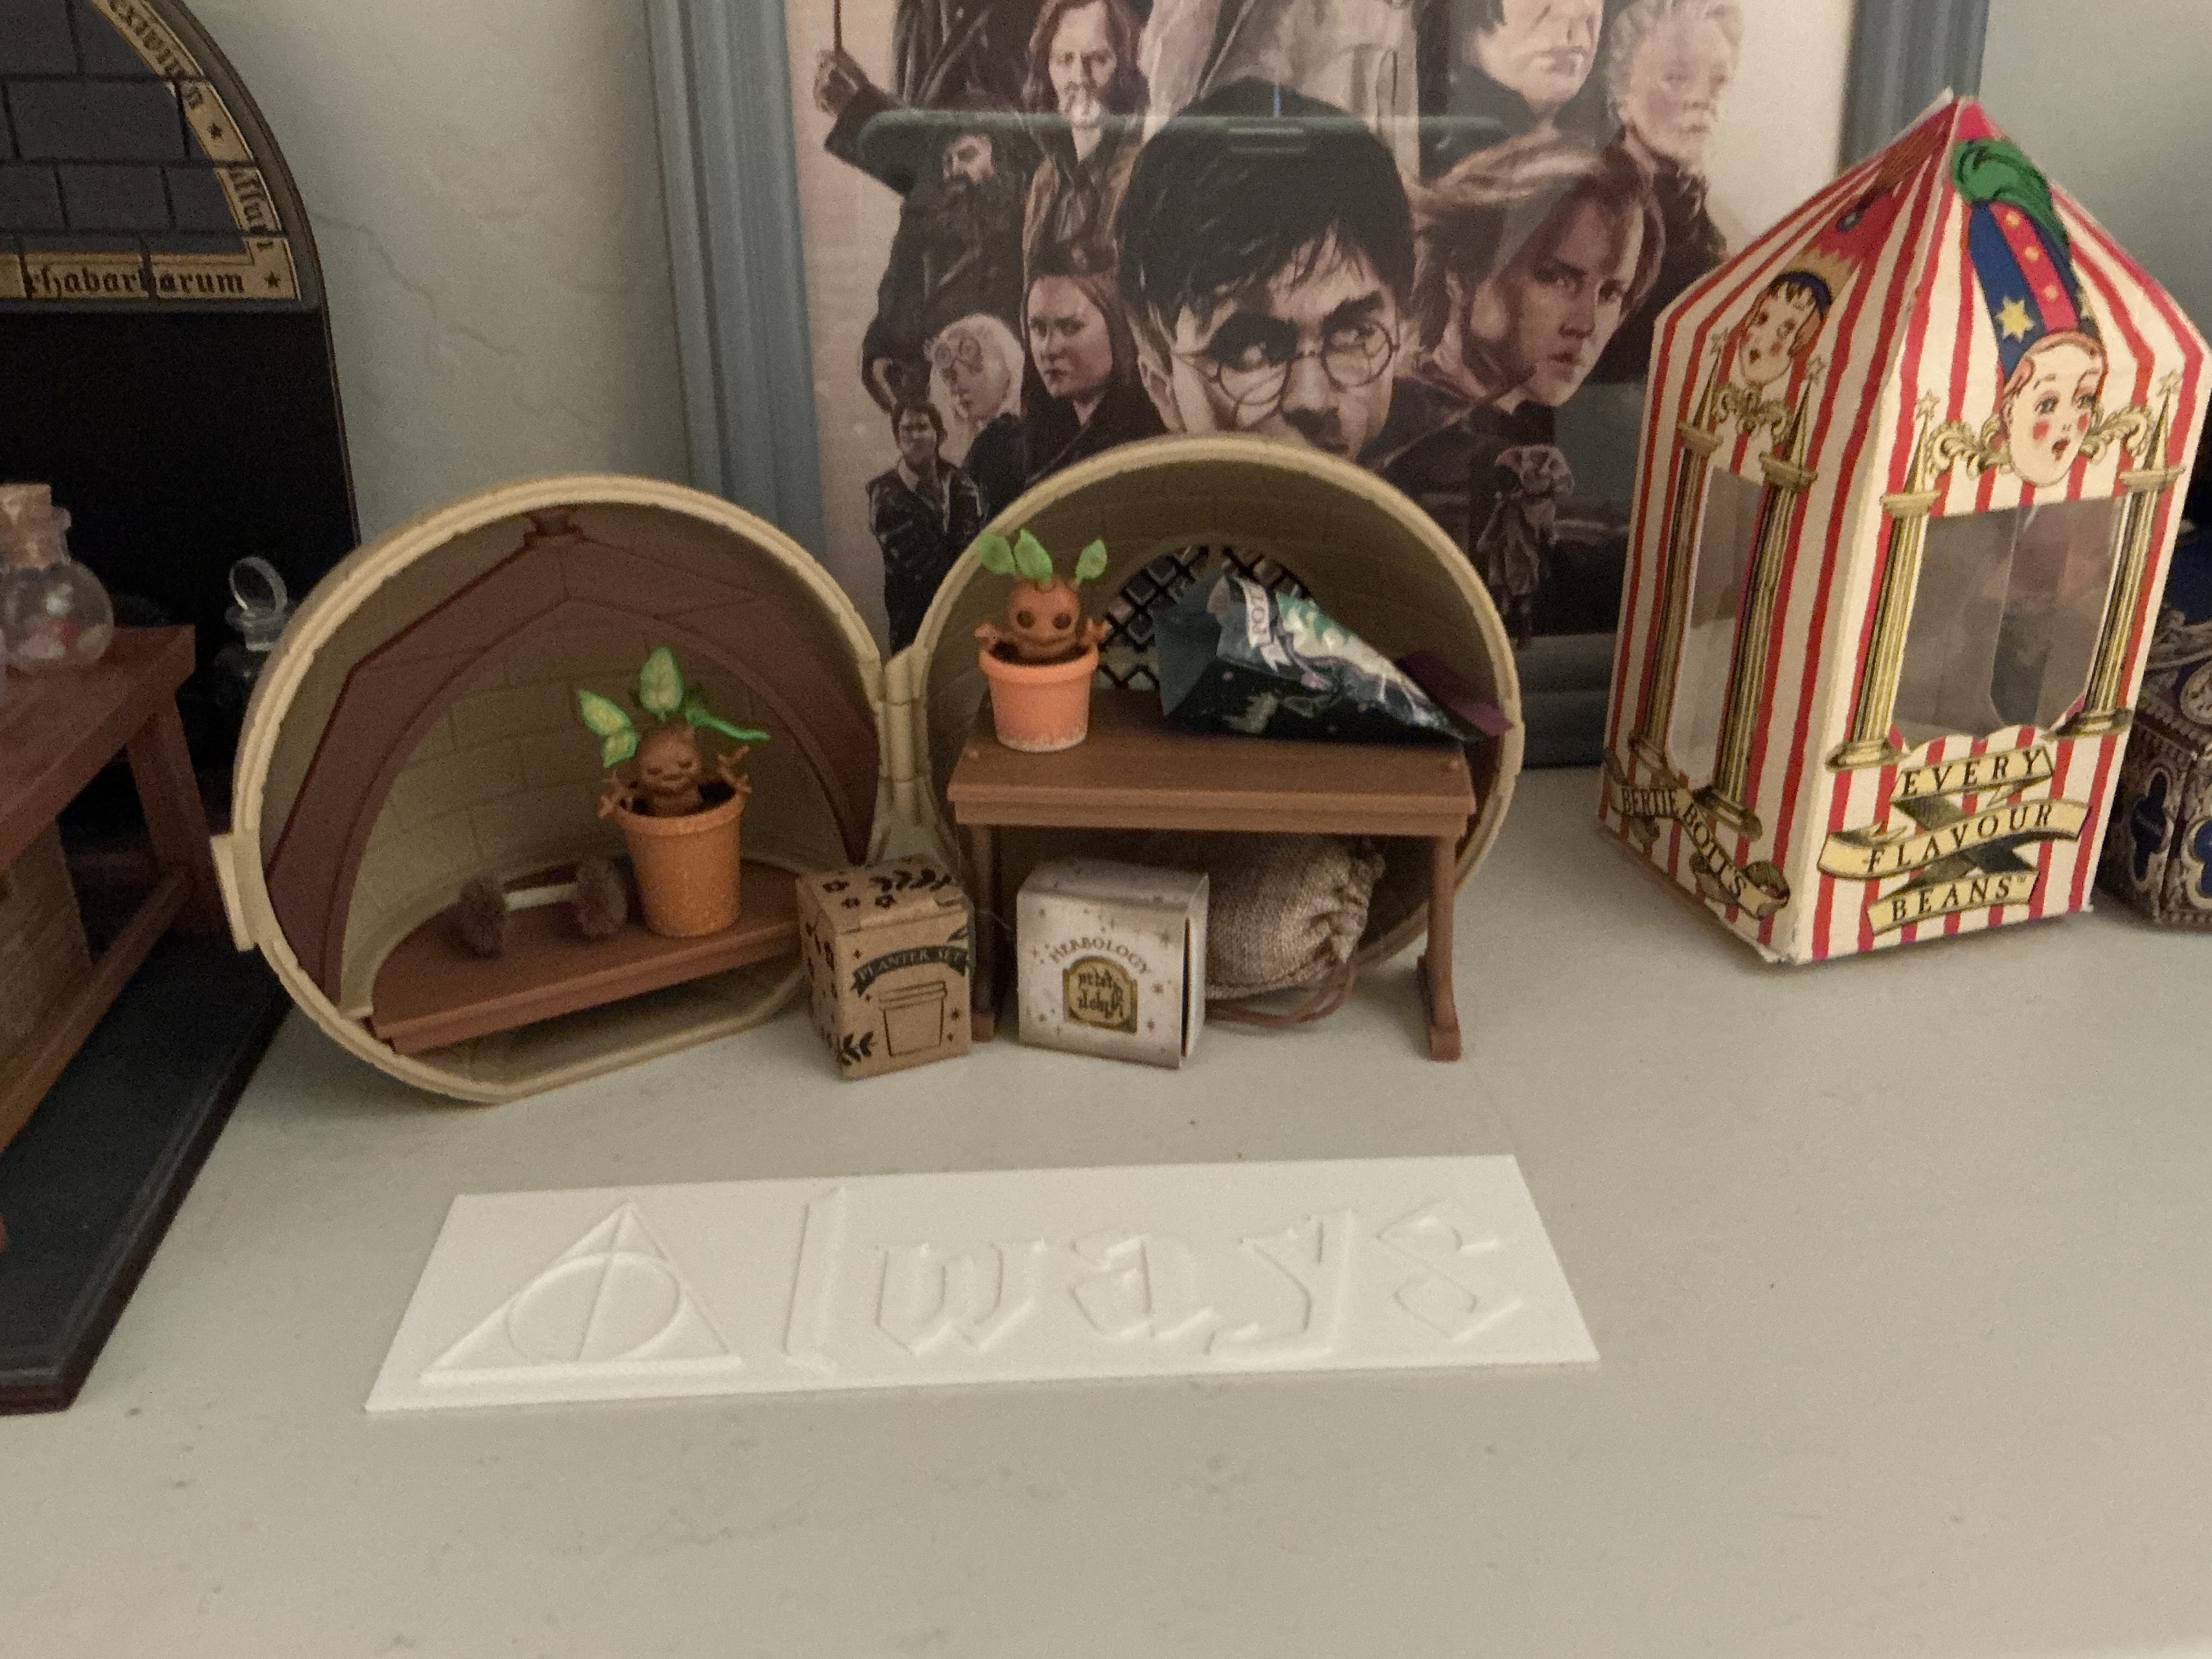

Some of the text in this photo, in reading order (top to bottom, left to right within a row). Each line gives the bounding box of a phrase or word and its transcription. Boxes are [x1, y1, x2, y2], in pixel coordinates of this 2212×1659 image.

[1901, 746, 2044, 797] EVERY
[1621, 787, 1679, 817] BERTIE
[1866, 804, 2053, 873] FLAVOUR
